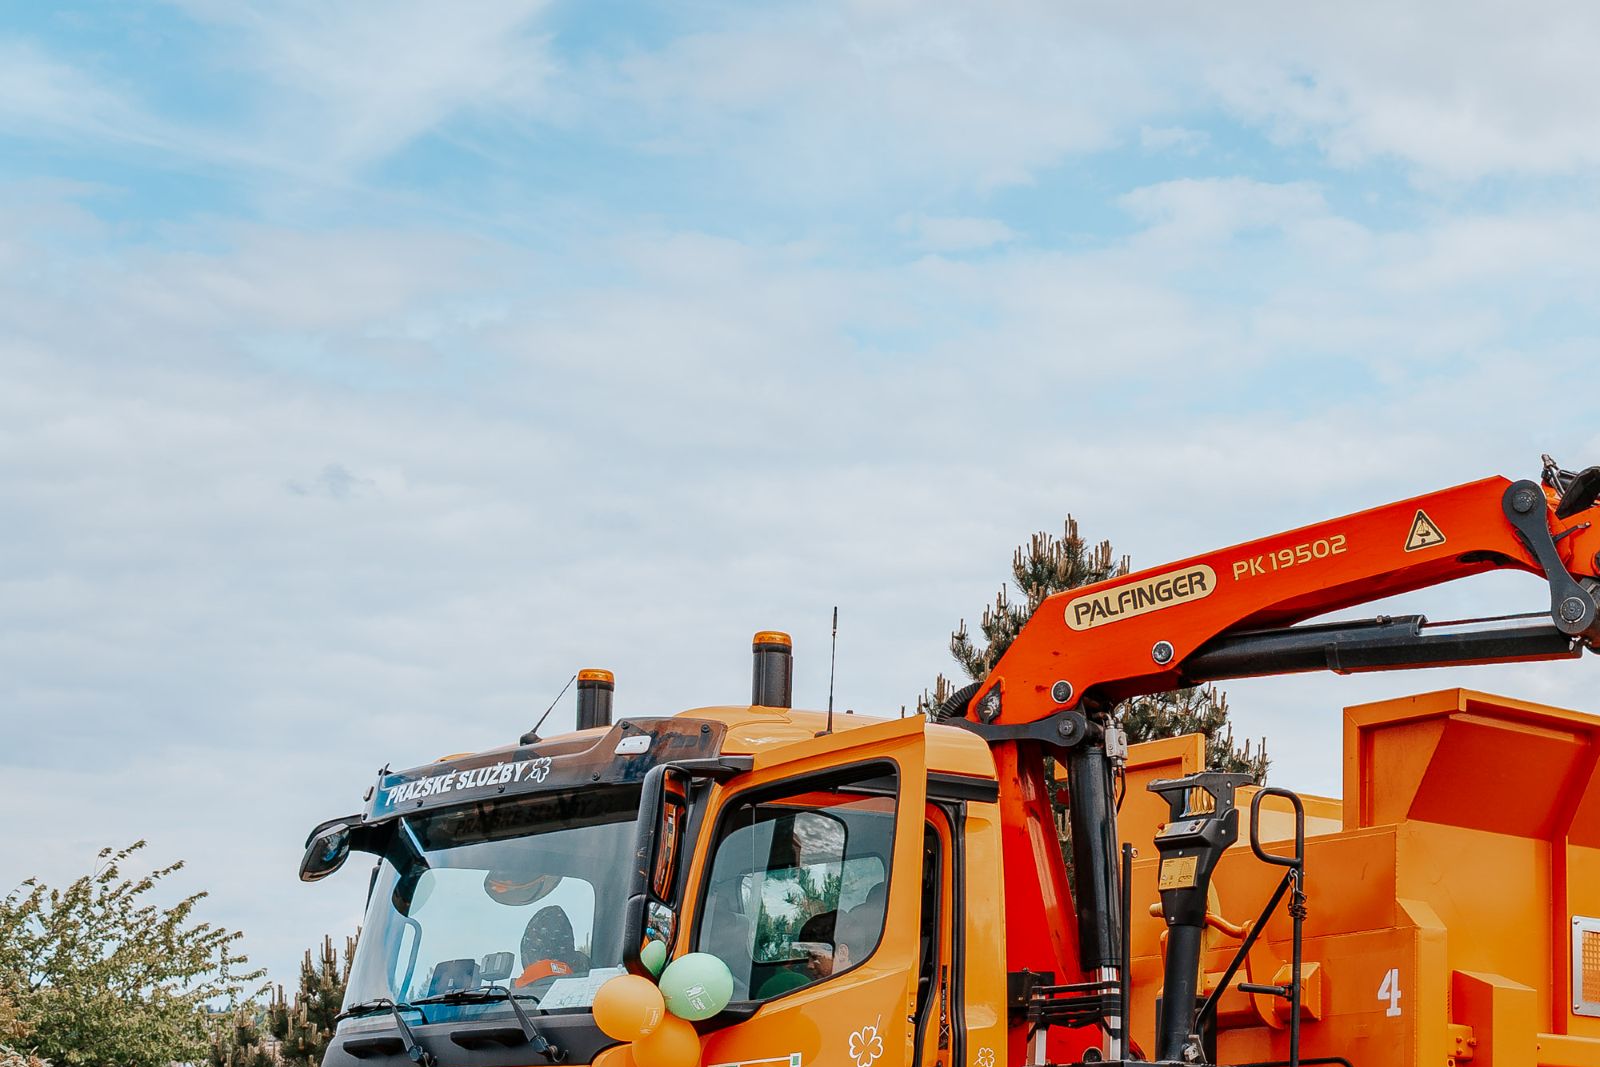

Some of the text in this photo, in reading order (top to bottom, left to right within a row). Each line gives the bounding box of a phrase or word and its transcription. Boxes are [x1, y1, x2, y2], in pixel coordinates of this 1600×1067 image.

[1231, 534, 1347, 581] PK 19502
[1073, 571, 1207, 626] PALFINGER
[384, 761, 529, 807] PRAŽSKÉ SLUŽBY
[1377, 968, 1402, 1017] 4
